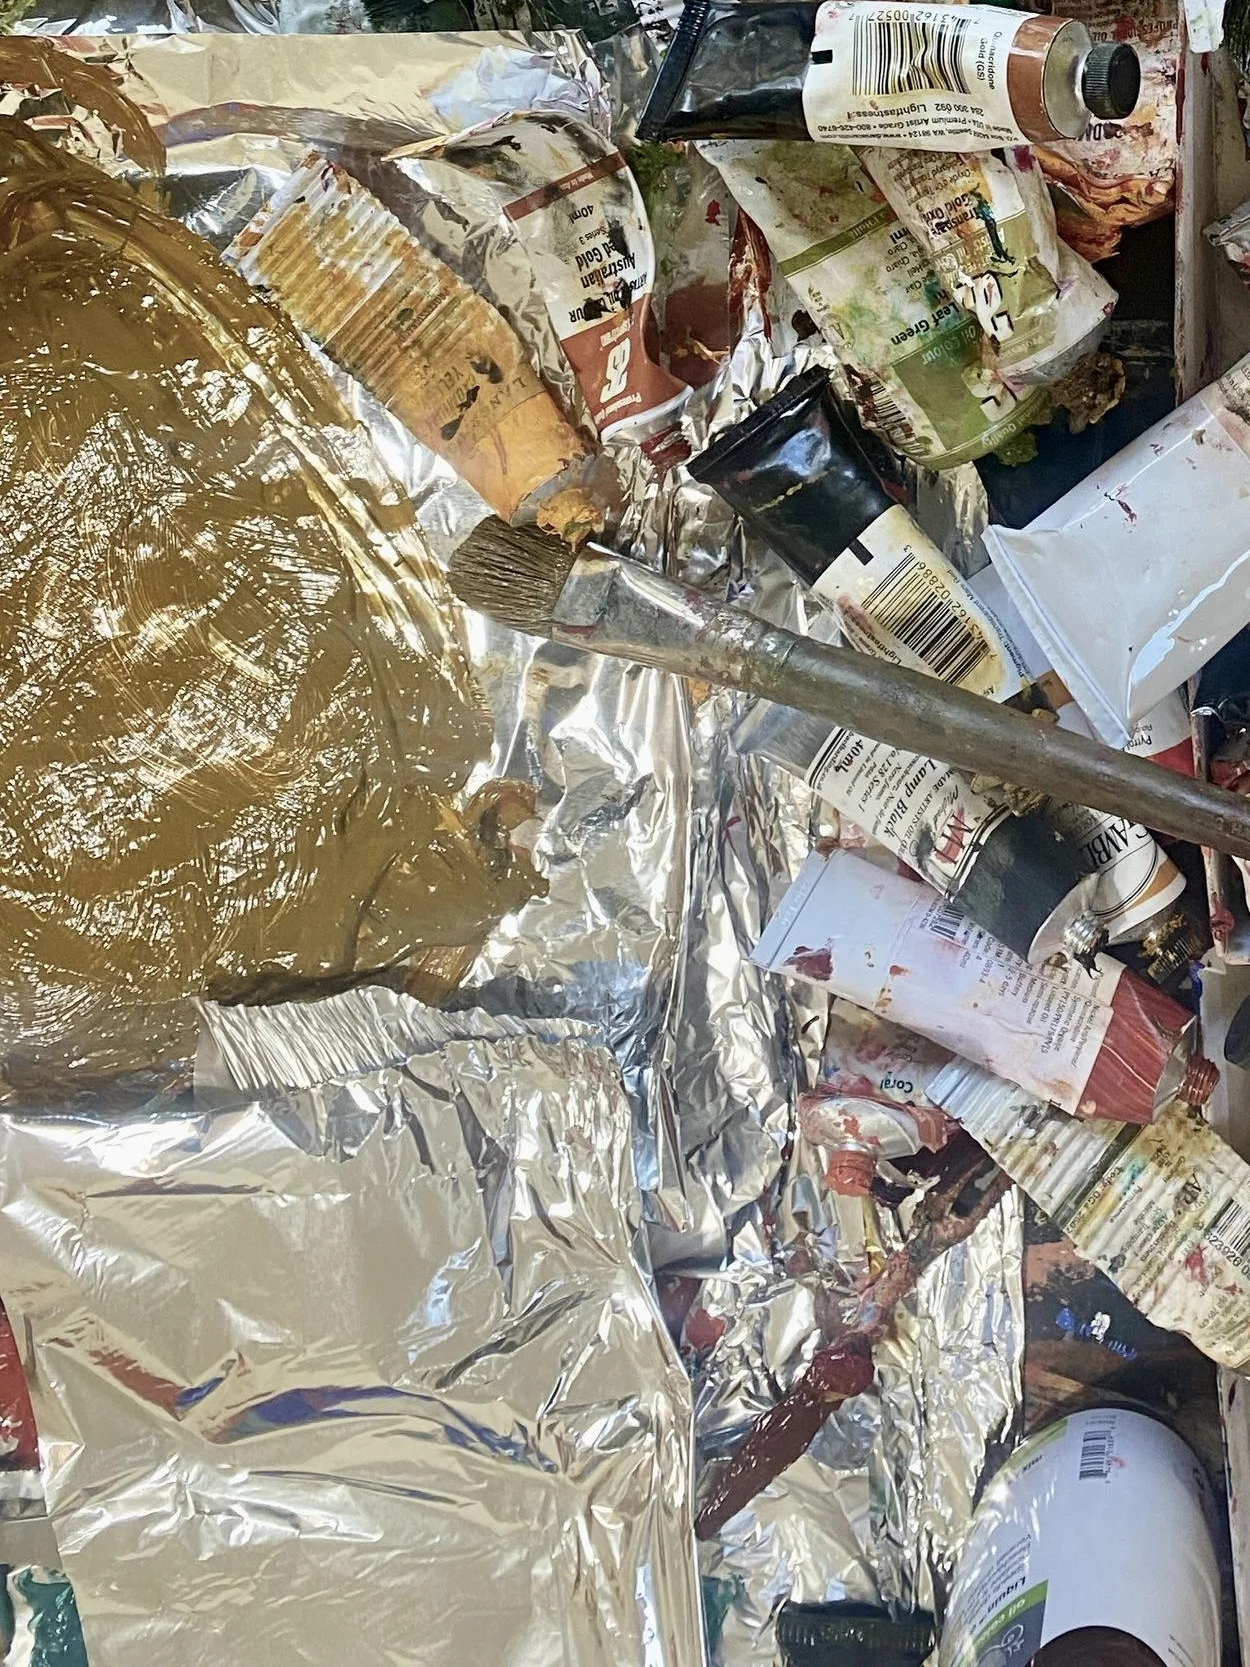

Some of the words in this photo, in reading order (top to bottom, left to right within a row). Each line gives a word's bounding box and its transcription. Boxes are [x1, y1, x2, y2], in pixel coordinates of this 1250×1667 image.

[867, 7, 910, 24] 00527
[977, 37, 987, 60] Gold
[974, 60, 986, 81] (GS)
[877, 119, 904, 130] Grade
[906, 116, 929, 128] Artist
[931, 114, 966, 127] Premium
[931, 128, 943, 136] WA
[573, 246, 603, 270] Gold
[579, 251, 637, 288] Australian
[929, 301, 959, 325] Leaf
[888, 318, 931, 346] Green
[916, 562, 951, 599] 02886
[902, 754, 938, 802] Lamp
[882, 797, 909, 838] Black
